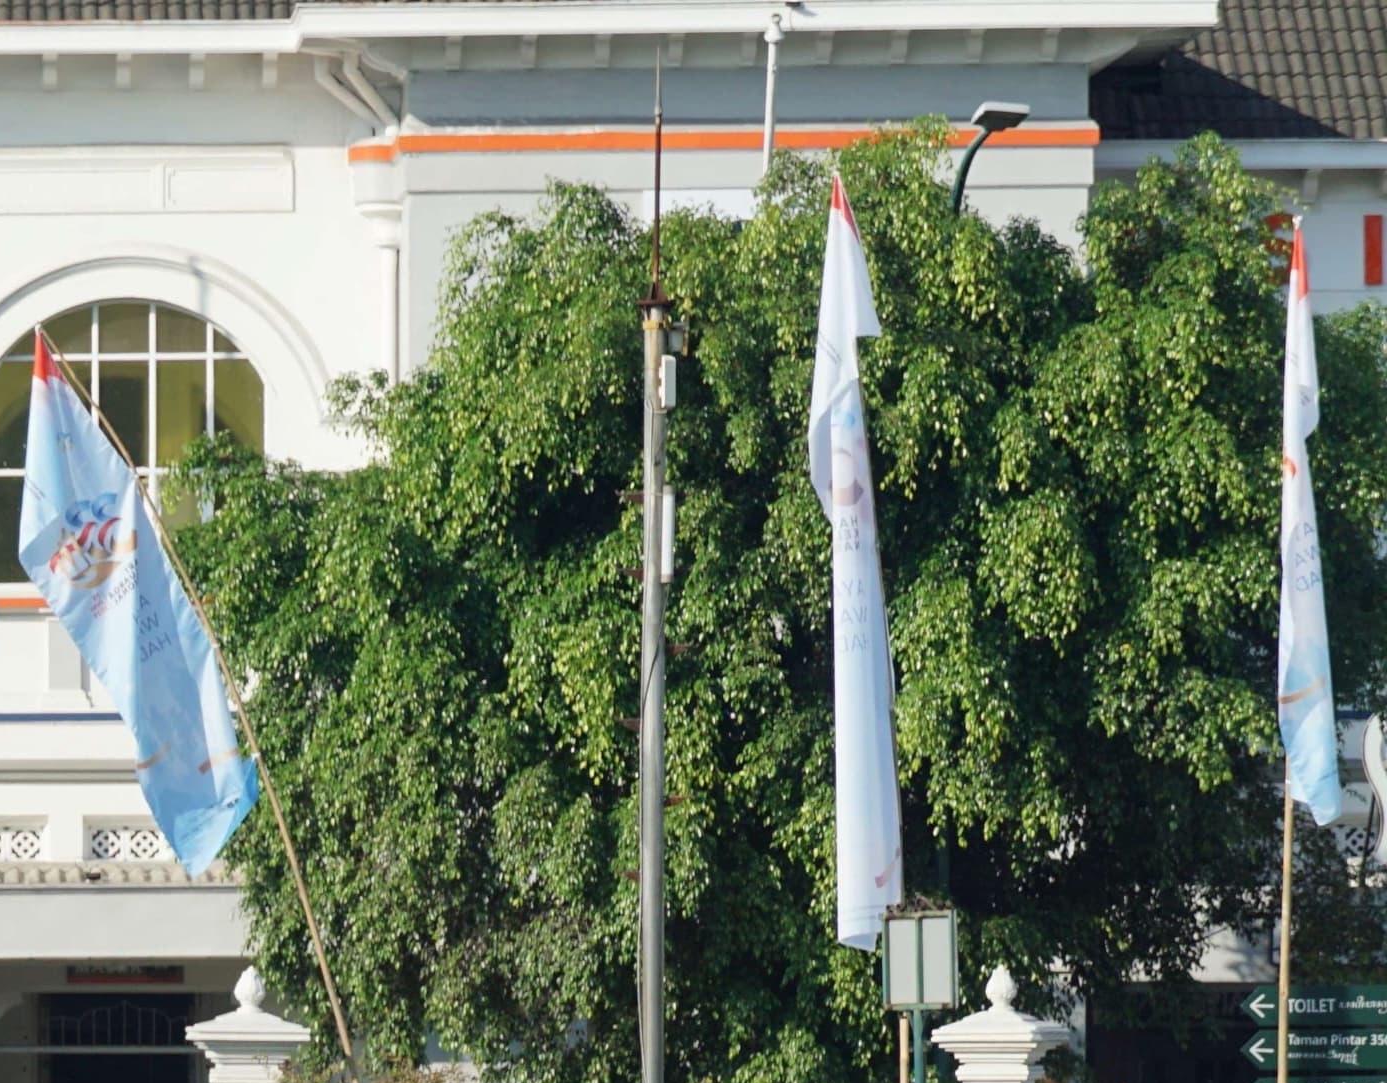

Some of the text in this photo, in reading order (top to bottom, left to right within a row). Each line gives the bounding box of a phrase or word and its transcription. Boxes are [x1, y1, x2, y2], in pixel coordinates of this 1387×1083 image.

[1288, 998, 1336, 1013] TOILET
[1288, 1033, 1327, 1047] Taman
[1330, 1033, 1368, 1047] Pintar
